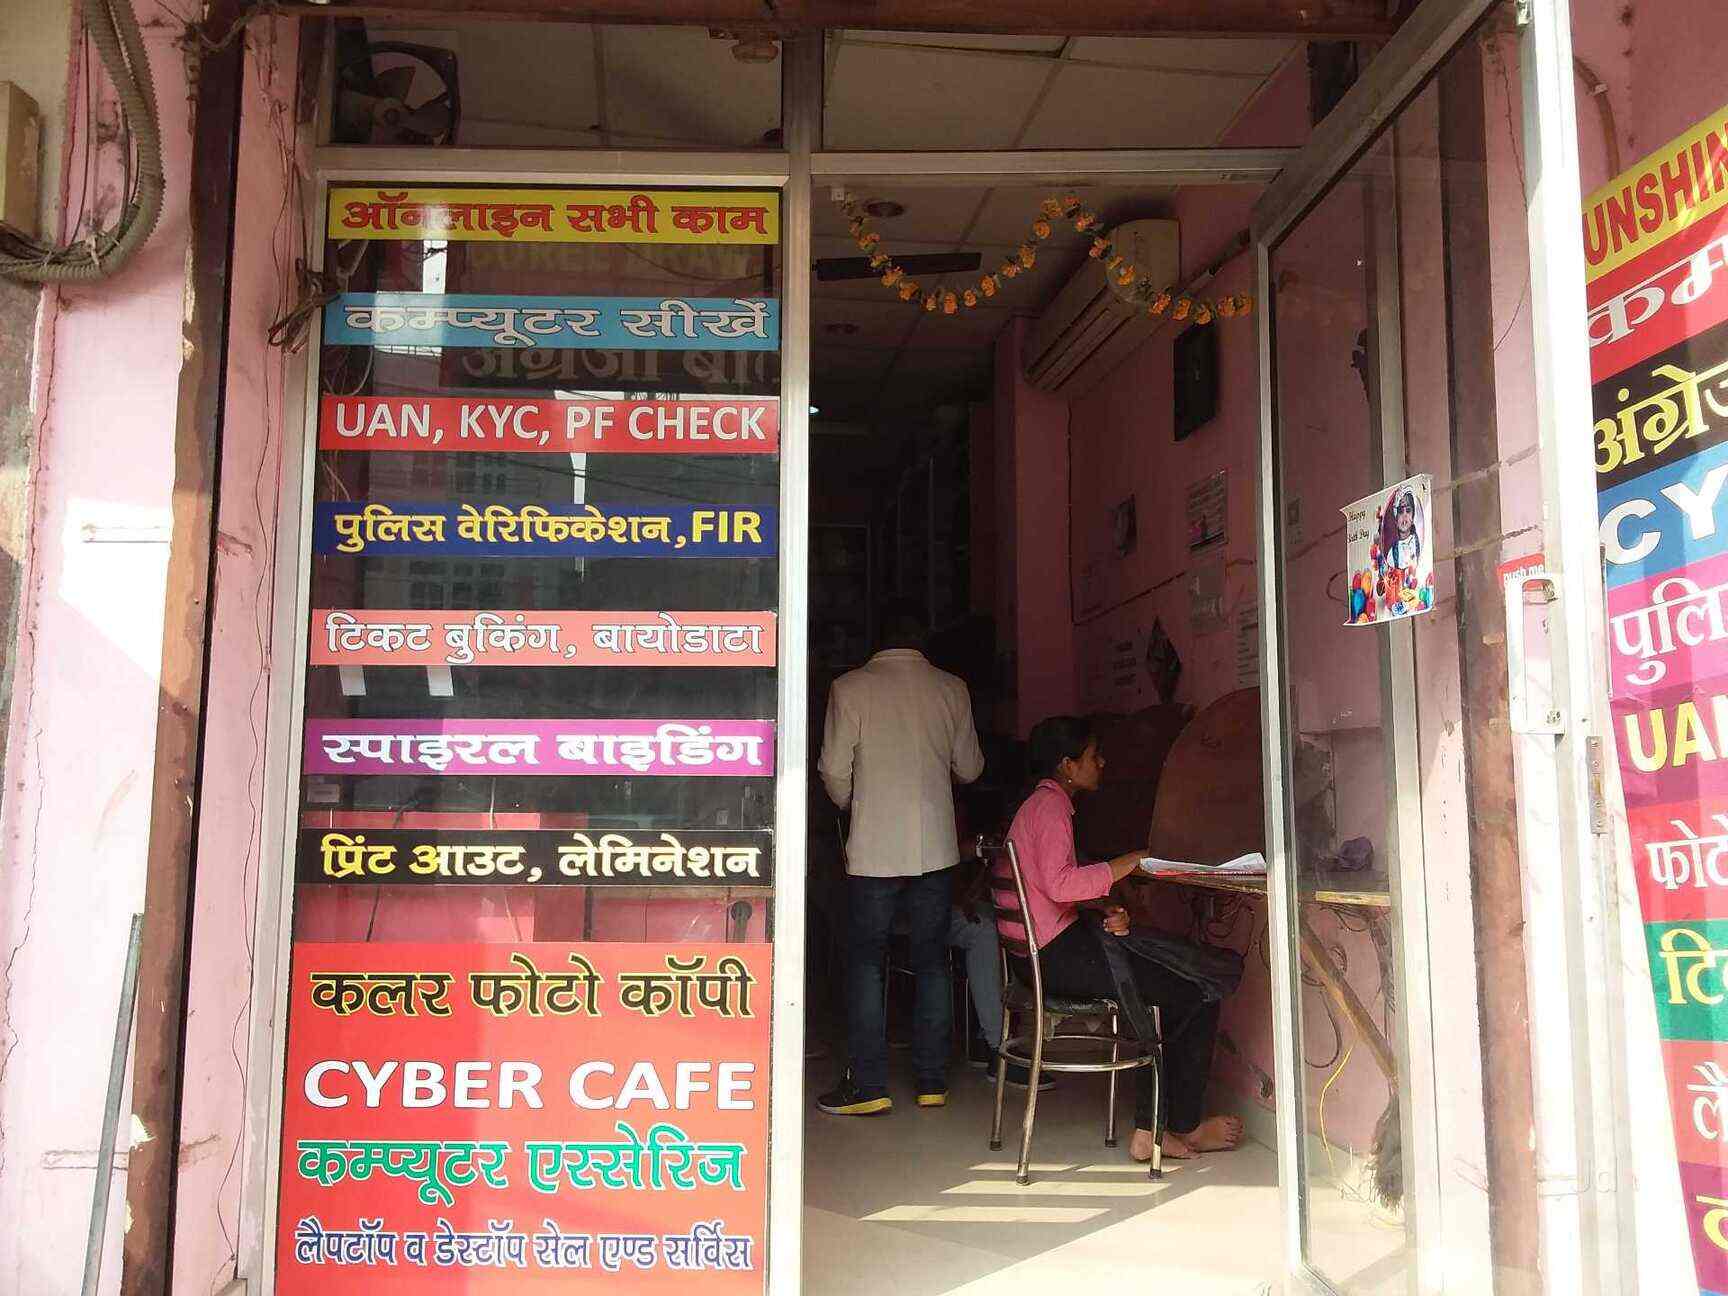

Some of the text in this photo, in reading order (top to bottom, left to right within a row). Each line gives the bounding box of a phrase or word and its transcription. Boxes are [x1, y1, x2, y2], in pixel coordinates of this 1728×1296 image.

[341, 191, 768, 238] ऑनलाइन सभी काम
[344, 298, 771, 347] कम्प्यूटर सीखें
[336, 403, 767, 445] UAN, KYC, PF CHECK
[334, 504, 446, 551] पुलिस
[326, 611, 762, 664] टिकट बुकिंग, बायोडाटा
[322, 724, 763, 771] स्पाइरल बाइडिंग
[320, 834, 761, 883] प्रिंट आउट, लेमिनेशन
[310, 952, 756, 1020] कलर फोटो कॉपी
[303, 1060, 756, 1110] CYBER CAFE
[297, 1120, 747, 1207] कम्प्यूटर एस्सेरिज
[295, 1217, 756, 1272] लैपटॉप व डेस्टॉप सेल एण्ड सर्विस
